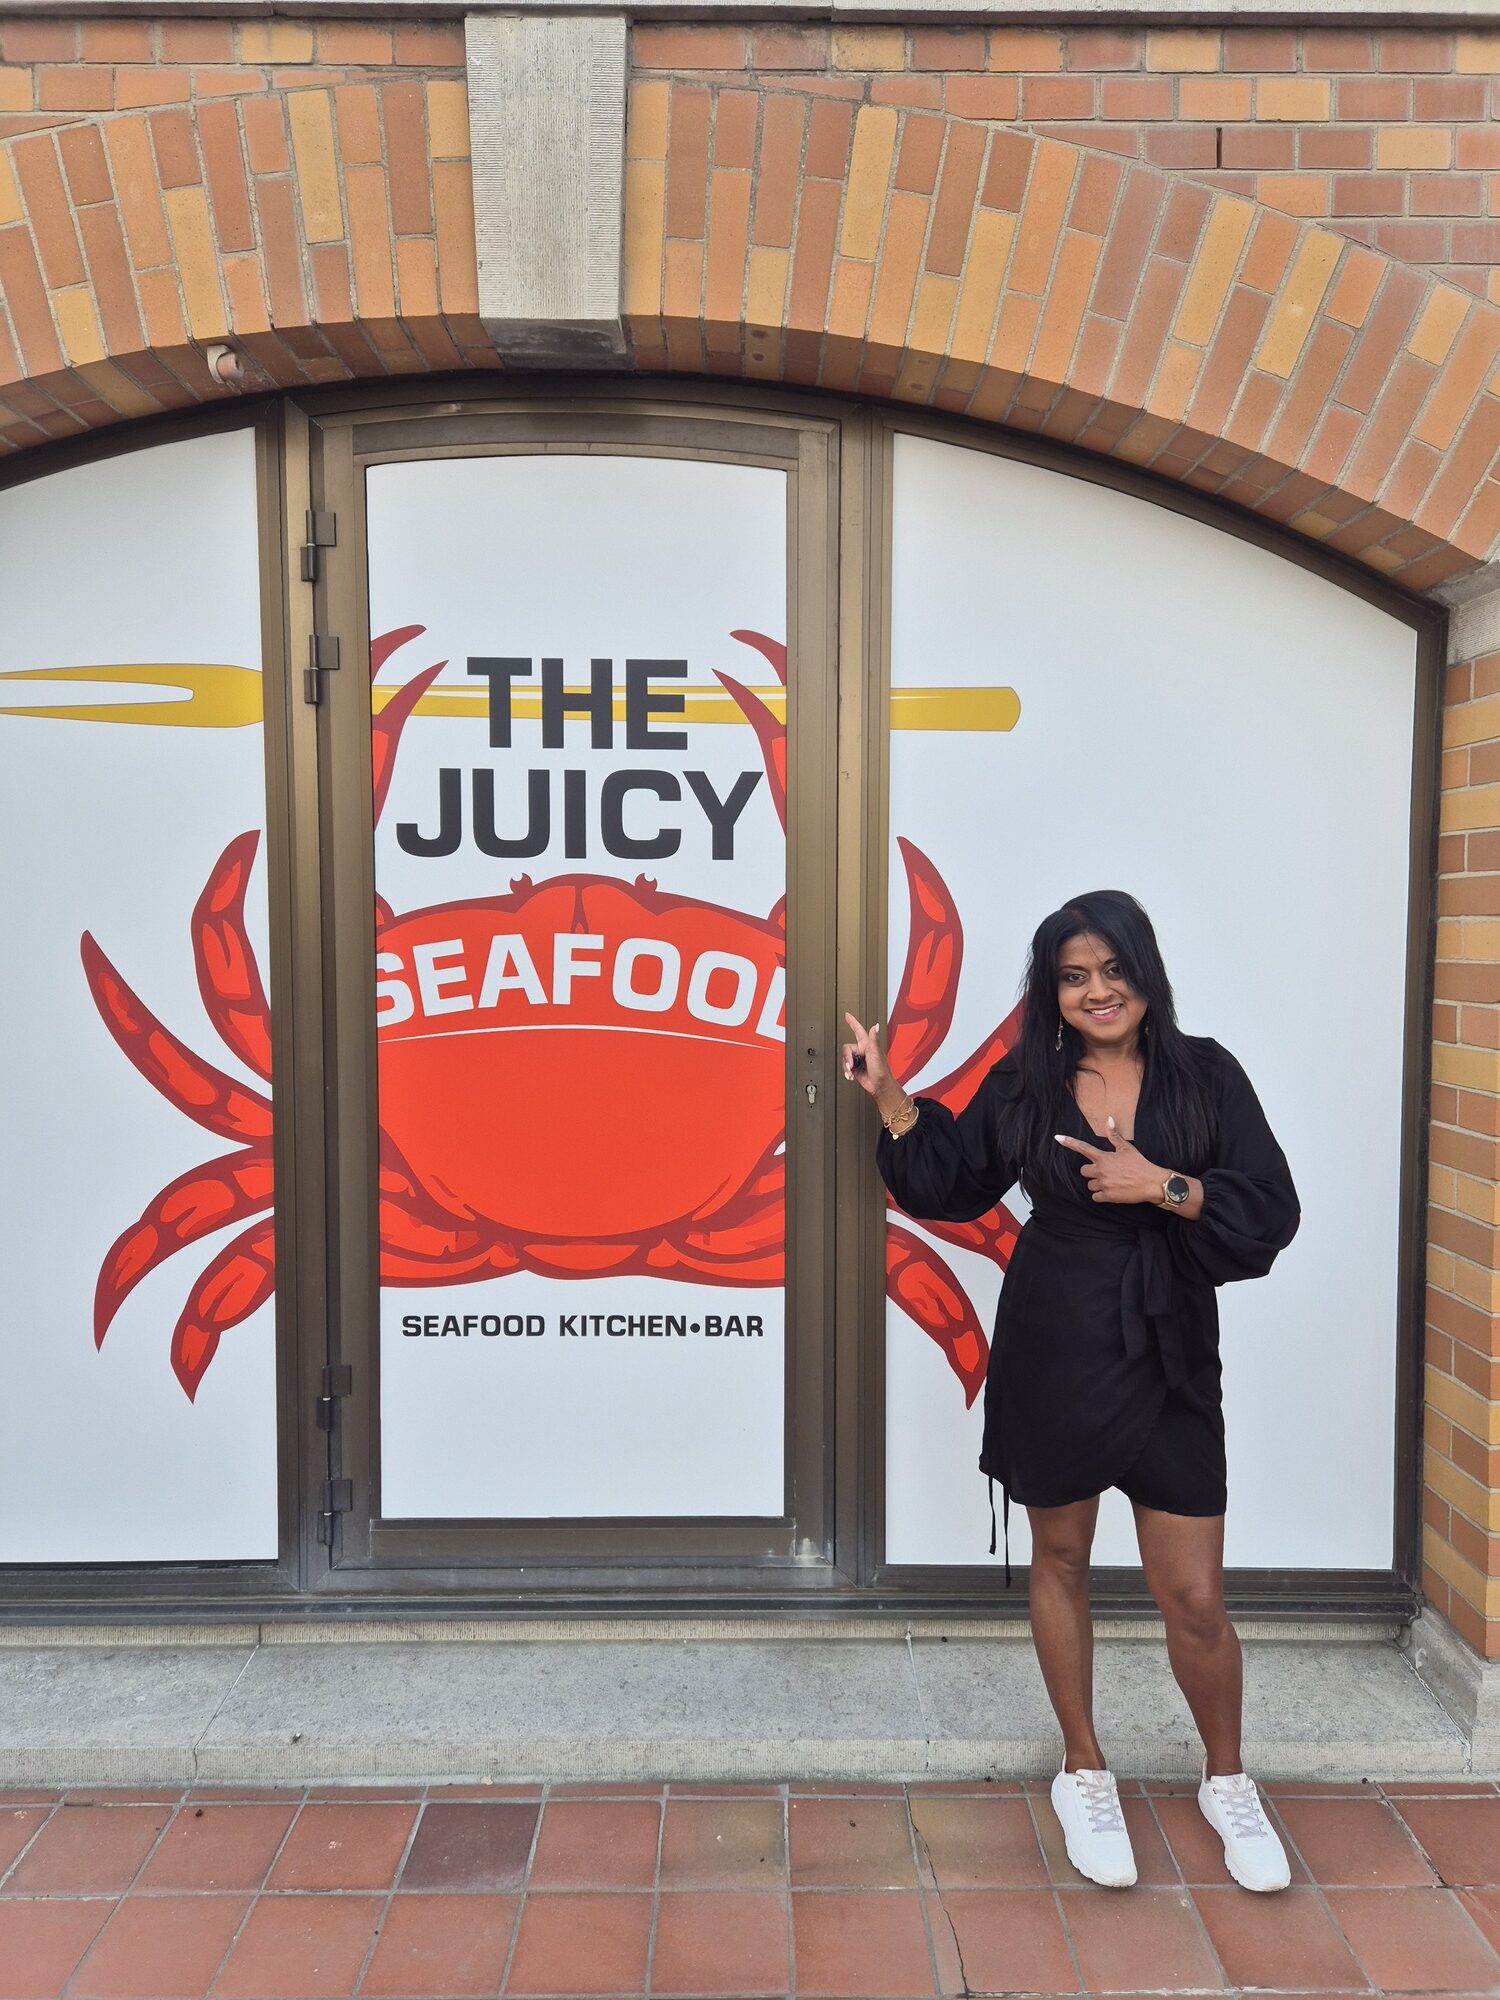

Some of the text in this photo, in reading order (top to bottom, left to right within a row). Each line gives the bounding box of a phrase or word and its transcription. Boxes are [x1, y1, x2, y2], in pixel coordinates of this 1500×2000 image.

[467, 657, 688, 750] THE
[396, 768, 764, 860] JUICY
[402, 1314, 546, 1337] SEAFOOD
